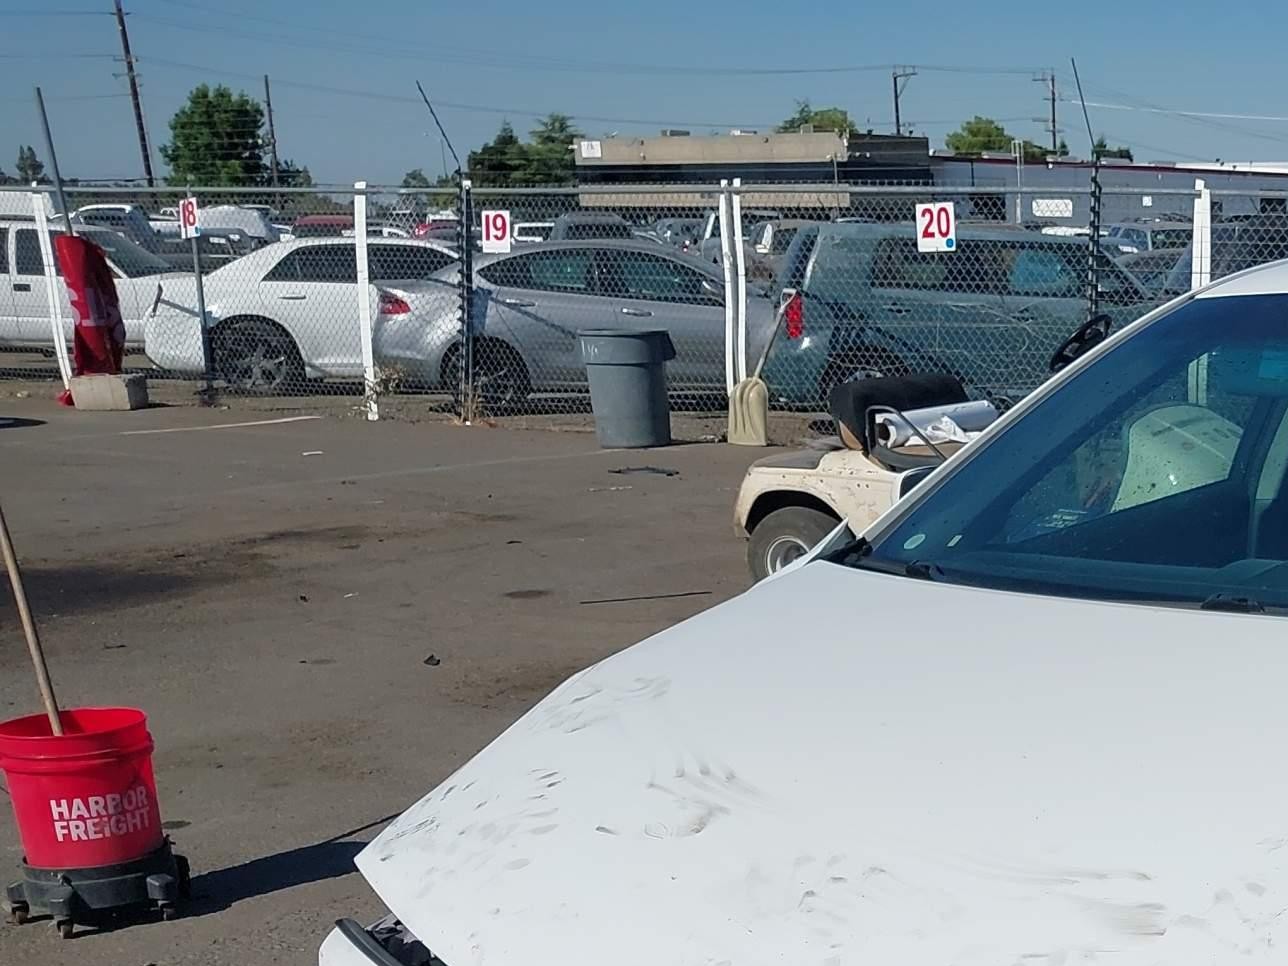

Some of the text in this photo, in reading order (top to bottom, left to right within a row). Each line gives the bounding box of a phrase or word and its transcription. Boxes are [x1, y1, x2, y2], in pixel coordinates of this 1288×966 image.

[484, 214, 508, 241] 19
[921, 207, 951, 238] 20
[50, 786, 149, 820] HARBOR
